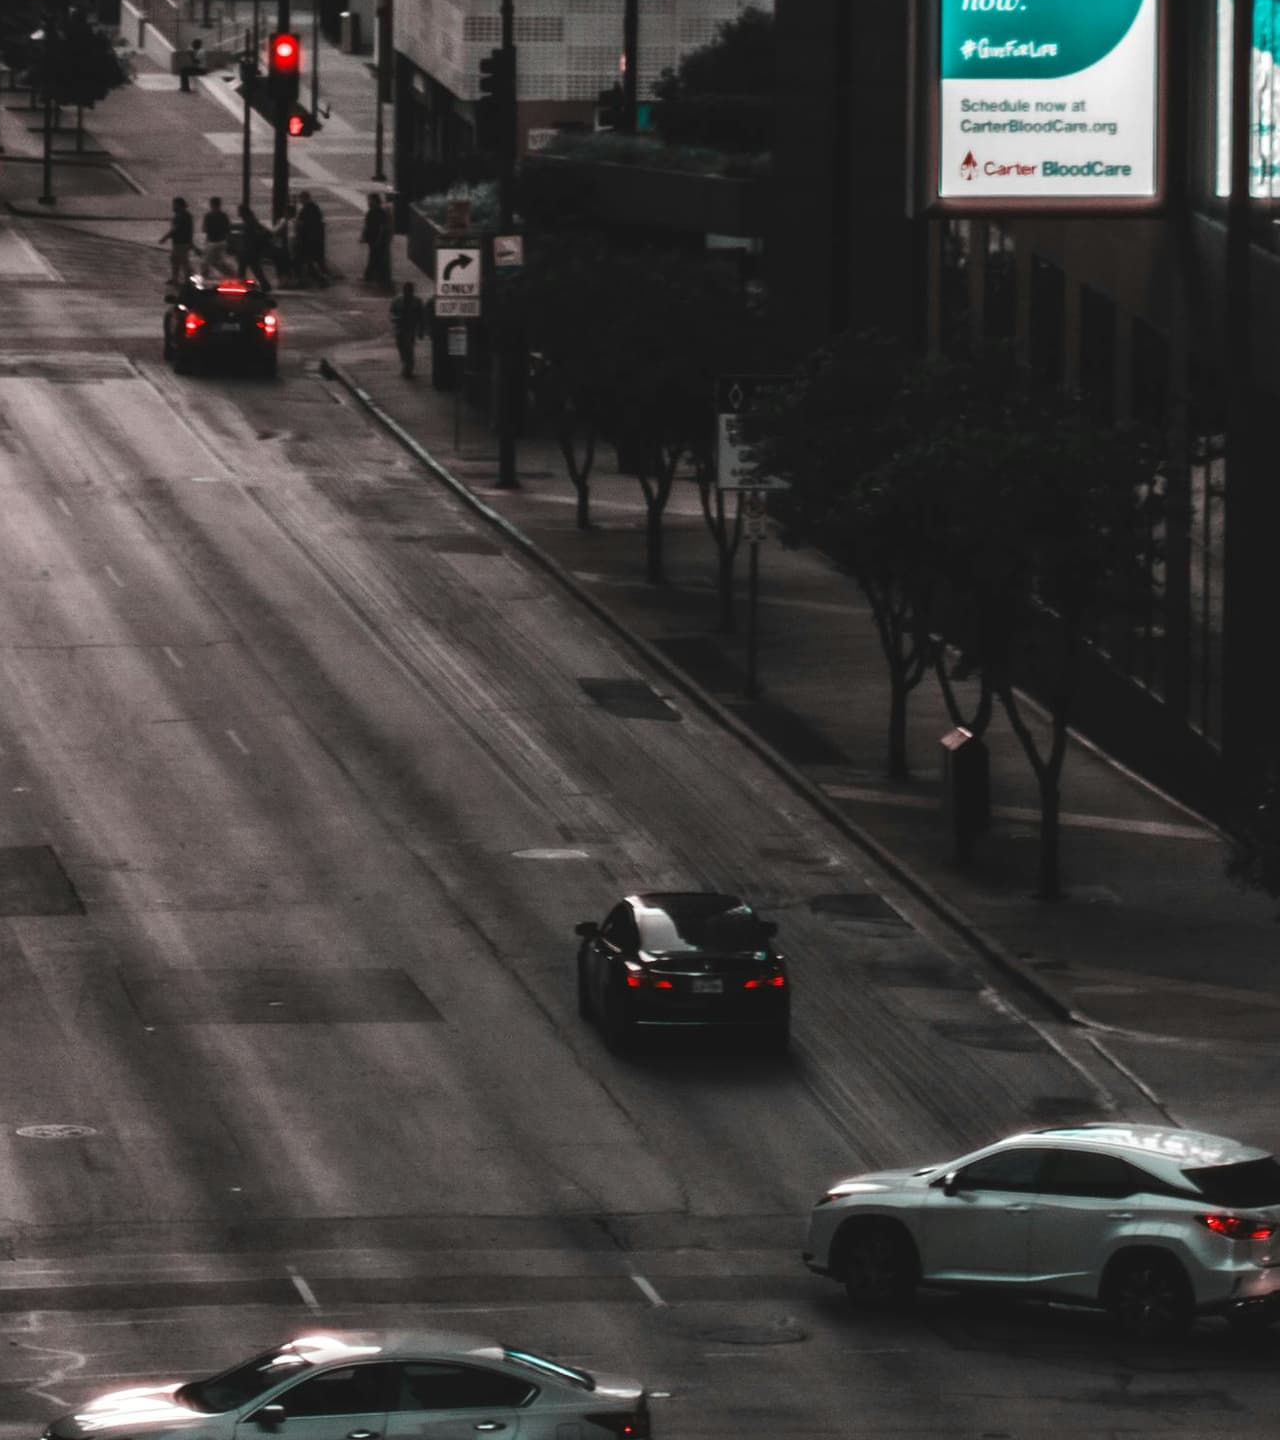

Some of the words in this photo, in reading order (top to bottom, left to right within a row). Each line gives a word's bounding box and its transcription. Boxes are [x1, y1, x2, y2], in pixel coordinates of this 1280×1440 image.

[960, 98, 1030, 113] Schedule
[1035, 102, 1067, 113] now
[1071, 99, 1086, 113] at
[960, 118, 1118, 135] CarterBloodCare.org
[984, 160, 1037, 176] Carter
[1042, 160, 1132, 177] BloodCare
[441, 284, 475, 294] ONLY
